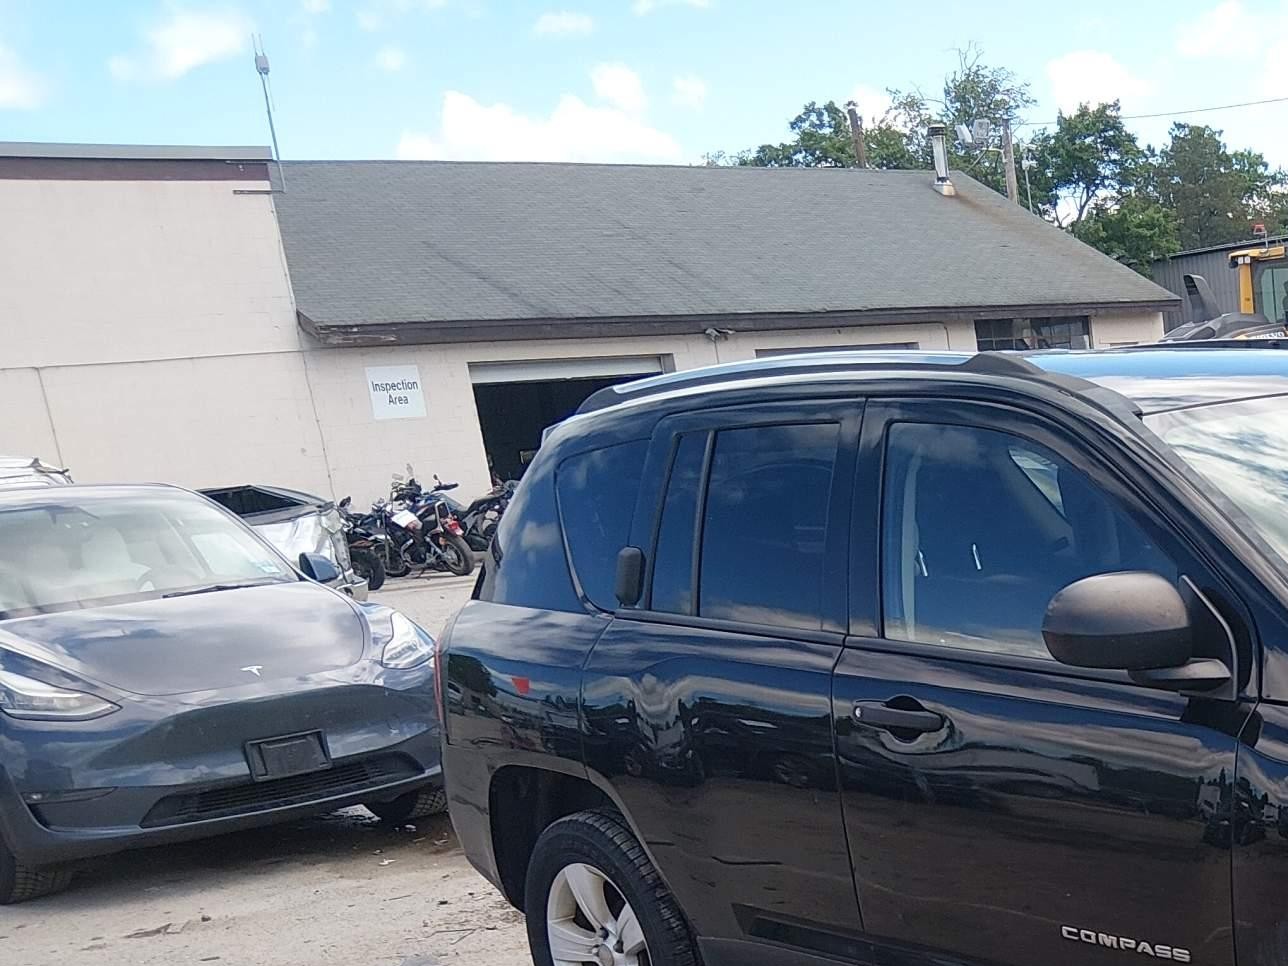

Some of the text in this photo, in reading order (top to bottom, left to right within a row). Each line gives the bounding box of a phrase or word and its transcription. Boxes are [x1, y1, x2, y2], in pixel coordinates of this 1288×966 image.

[371, 379, 419, 394] Inspection
[388, 394, 409, 406] Area
[1060, 925, 1192, 962] COMPASS
